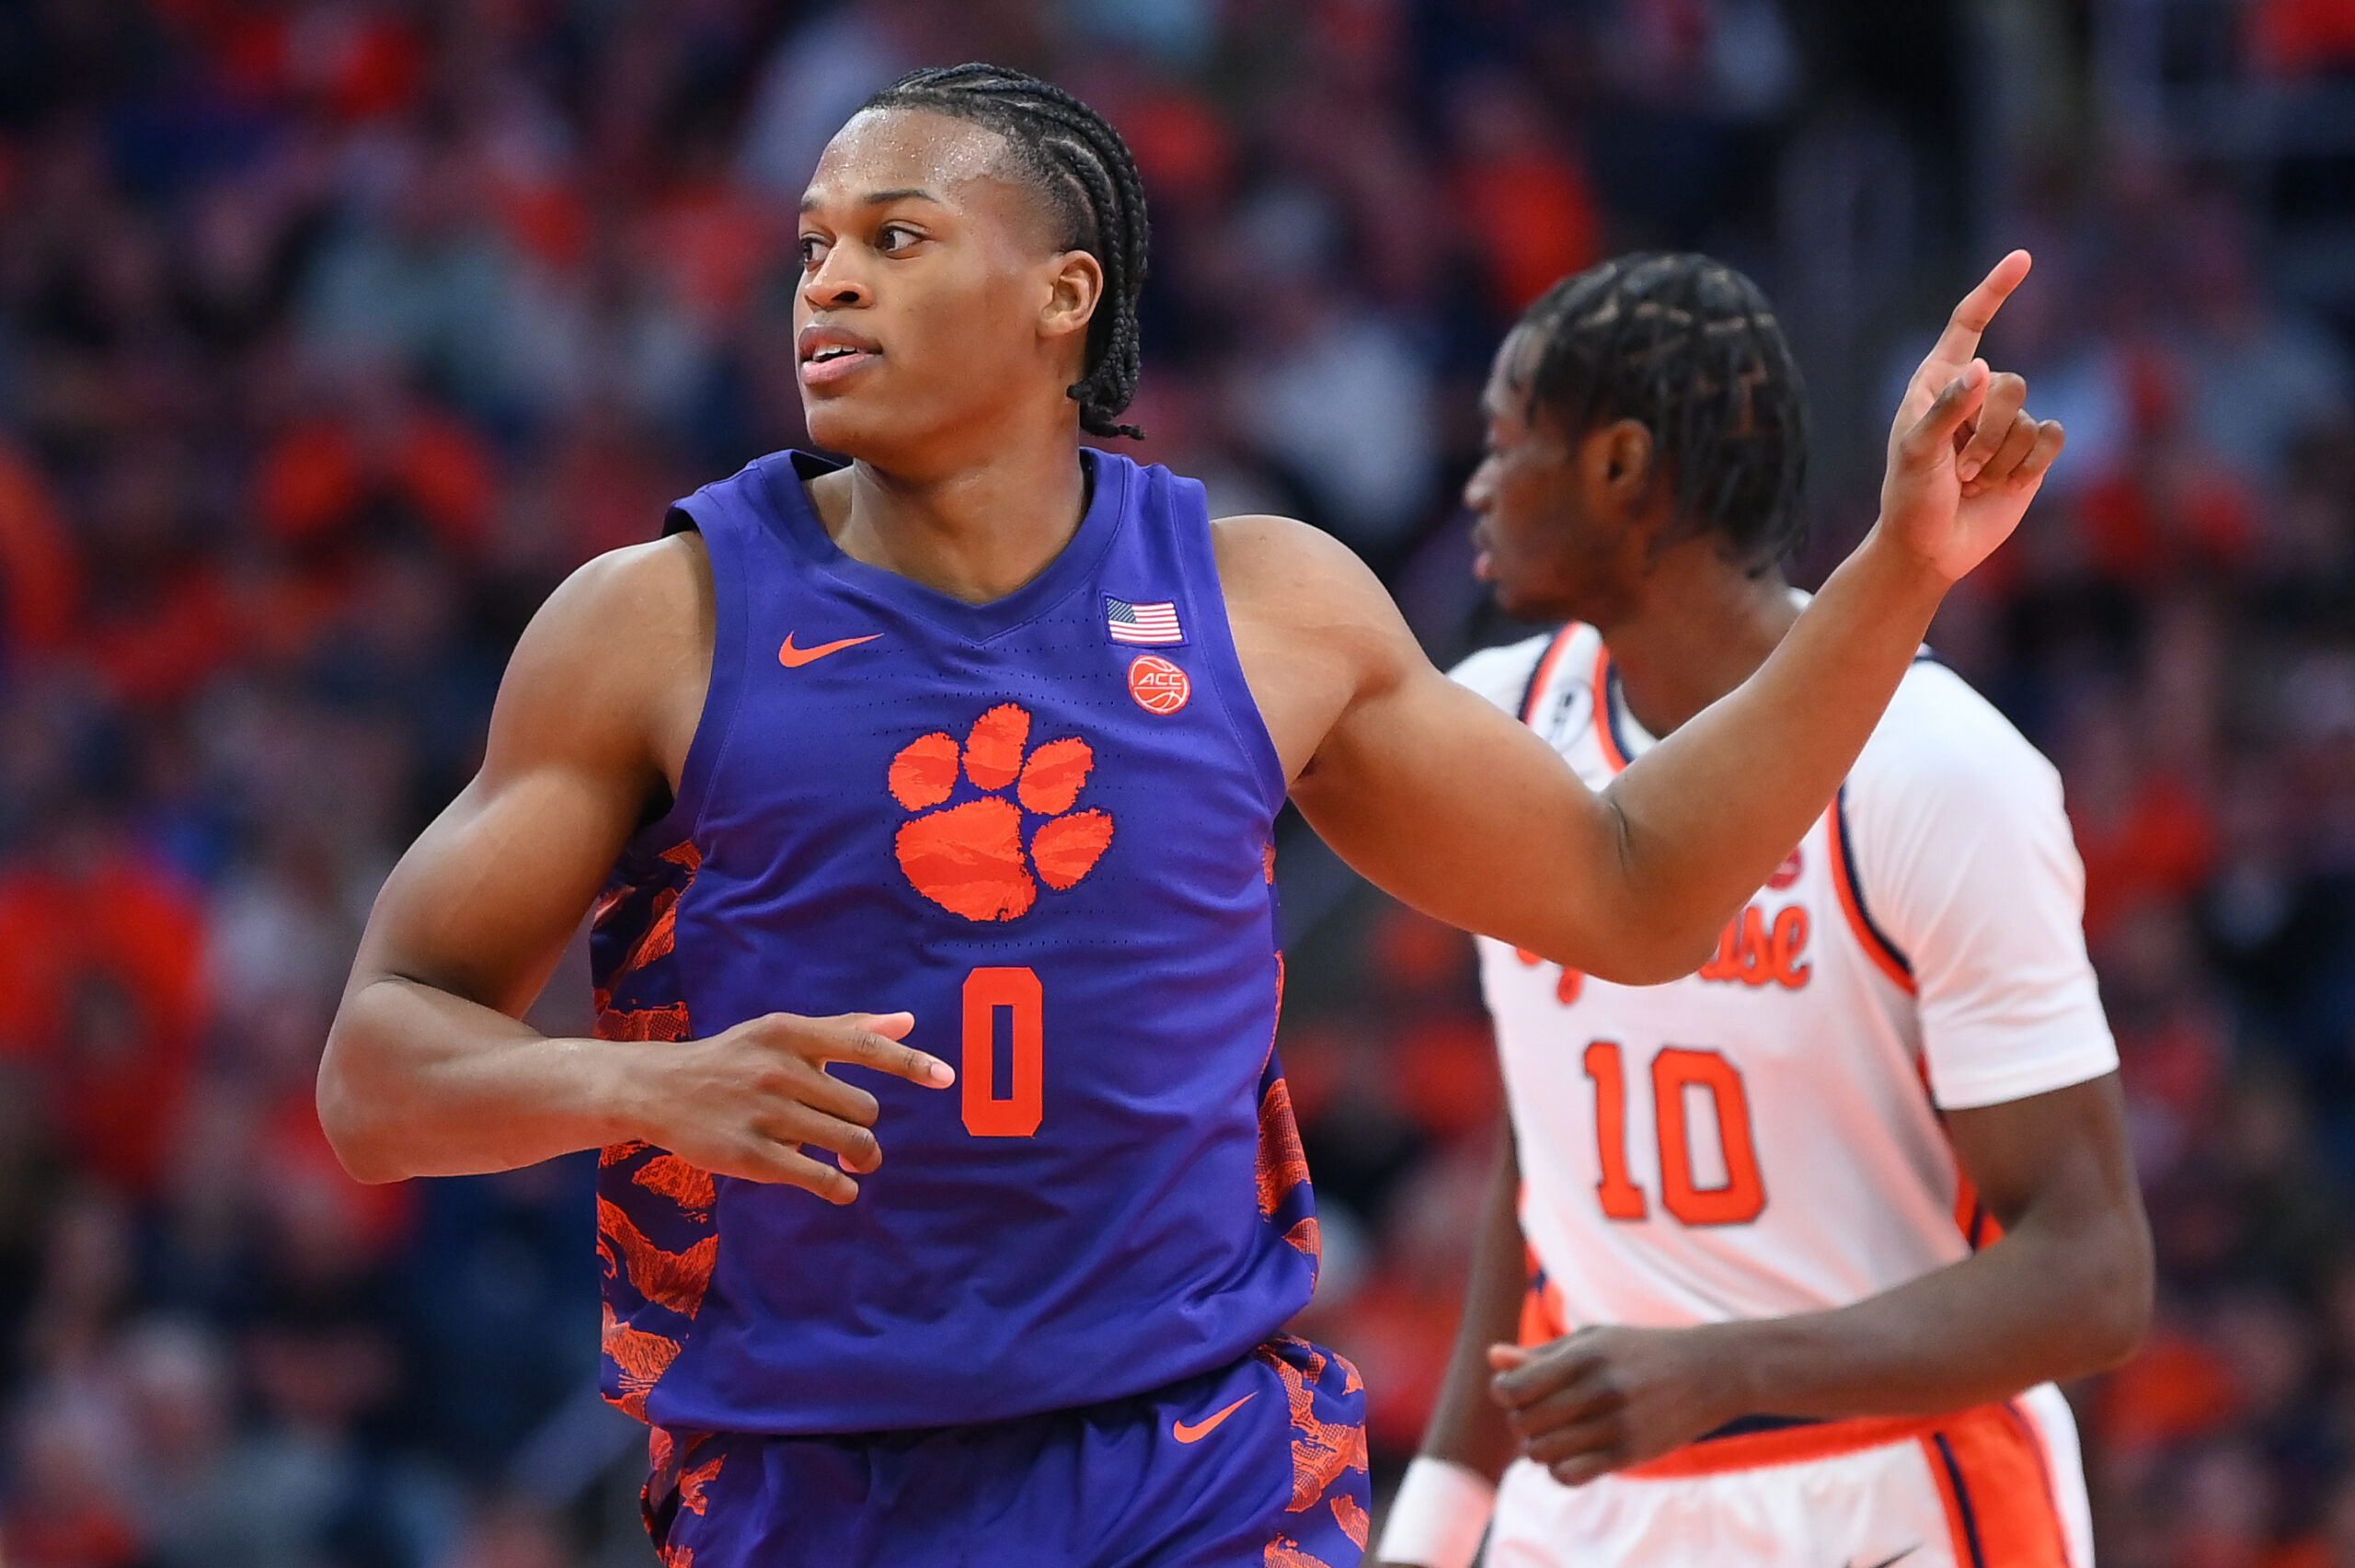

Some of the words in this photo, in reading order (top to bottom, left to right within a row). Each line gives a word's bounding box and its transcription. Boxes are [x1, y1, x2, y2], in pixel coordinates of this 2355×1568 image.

[1138, 672, 1183, 686] ACC
[961, 967, 1044, 1137] 0
[1582, 1041, 1767, 1226] 10
